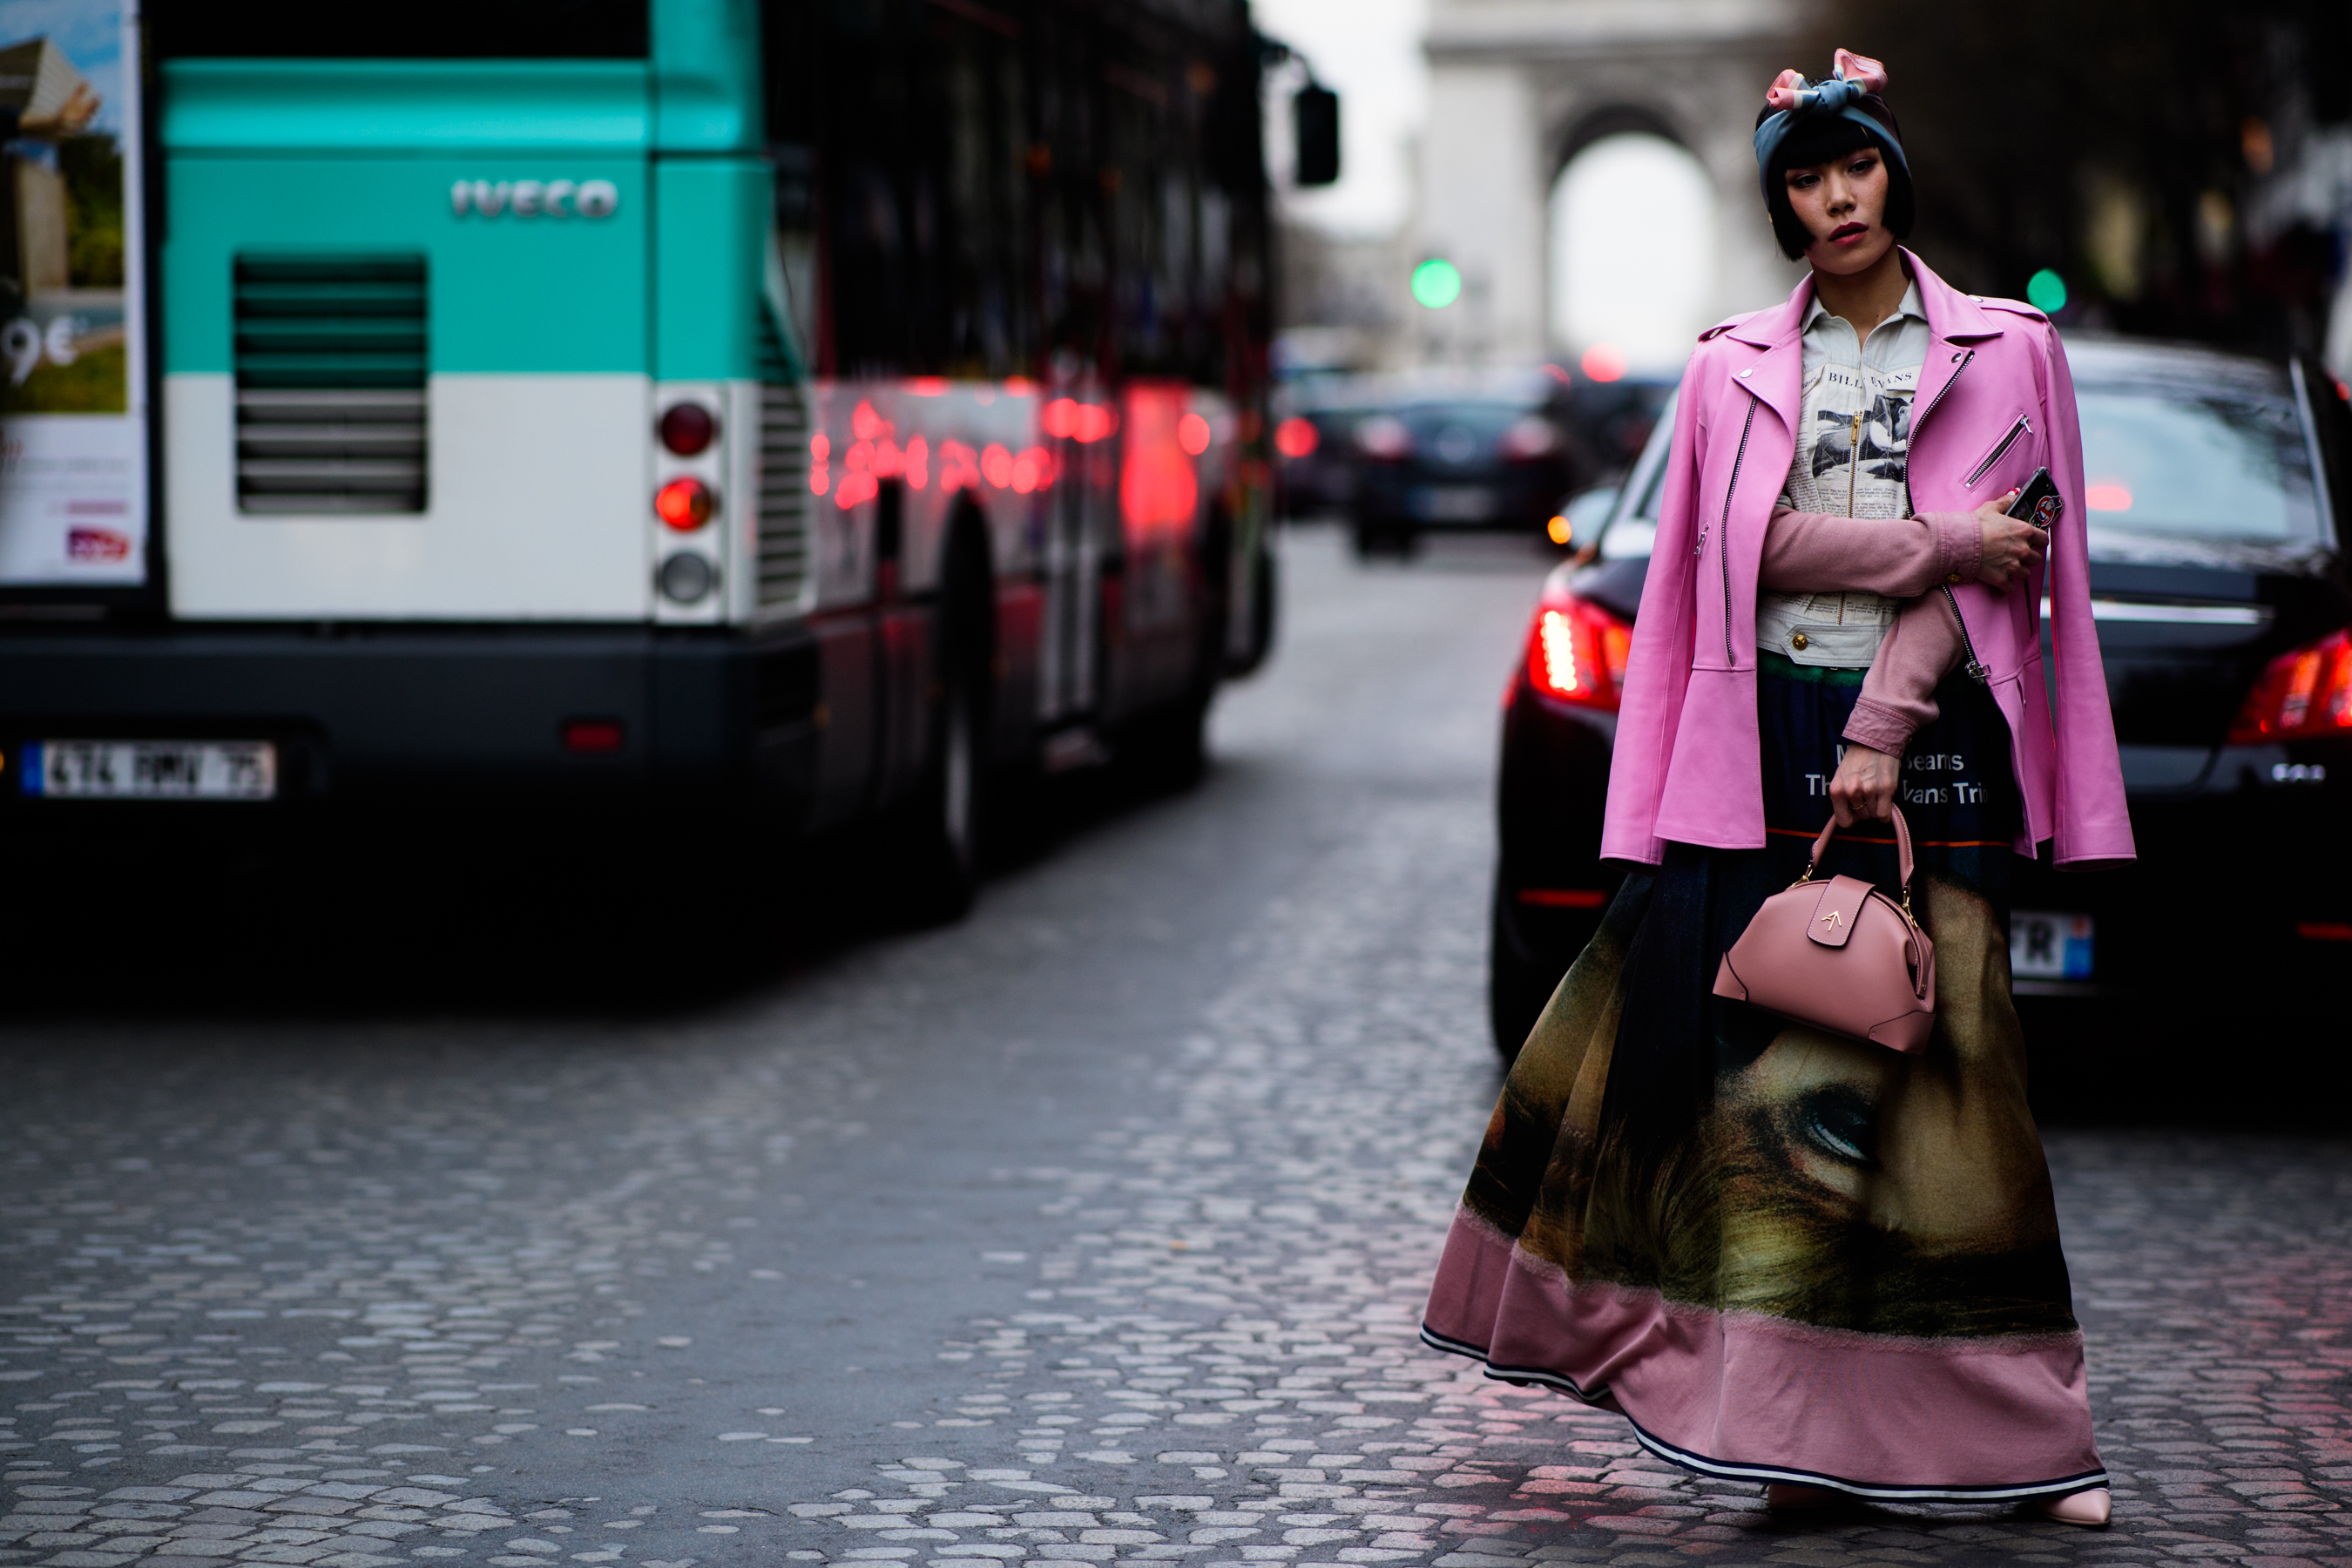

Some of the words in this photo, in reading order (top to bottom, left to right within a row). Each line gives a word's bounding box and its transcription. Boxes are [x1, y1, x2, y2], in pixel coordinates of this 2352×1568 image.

[449, 179, 618, 219] IVECO
[1828, 372, 1864, 389] BILL
[1870, 372, 1913, 389] EVANS
[1805, 774, 1832, 796] Th
[1951, 781, 1988, 805] Trio
